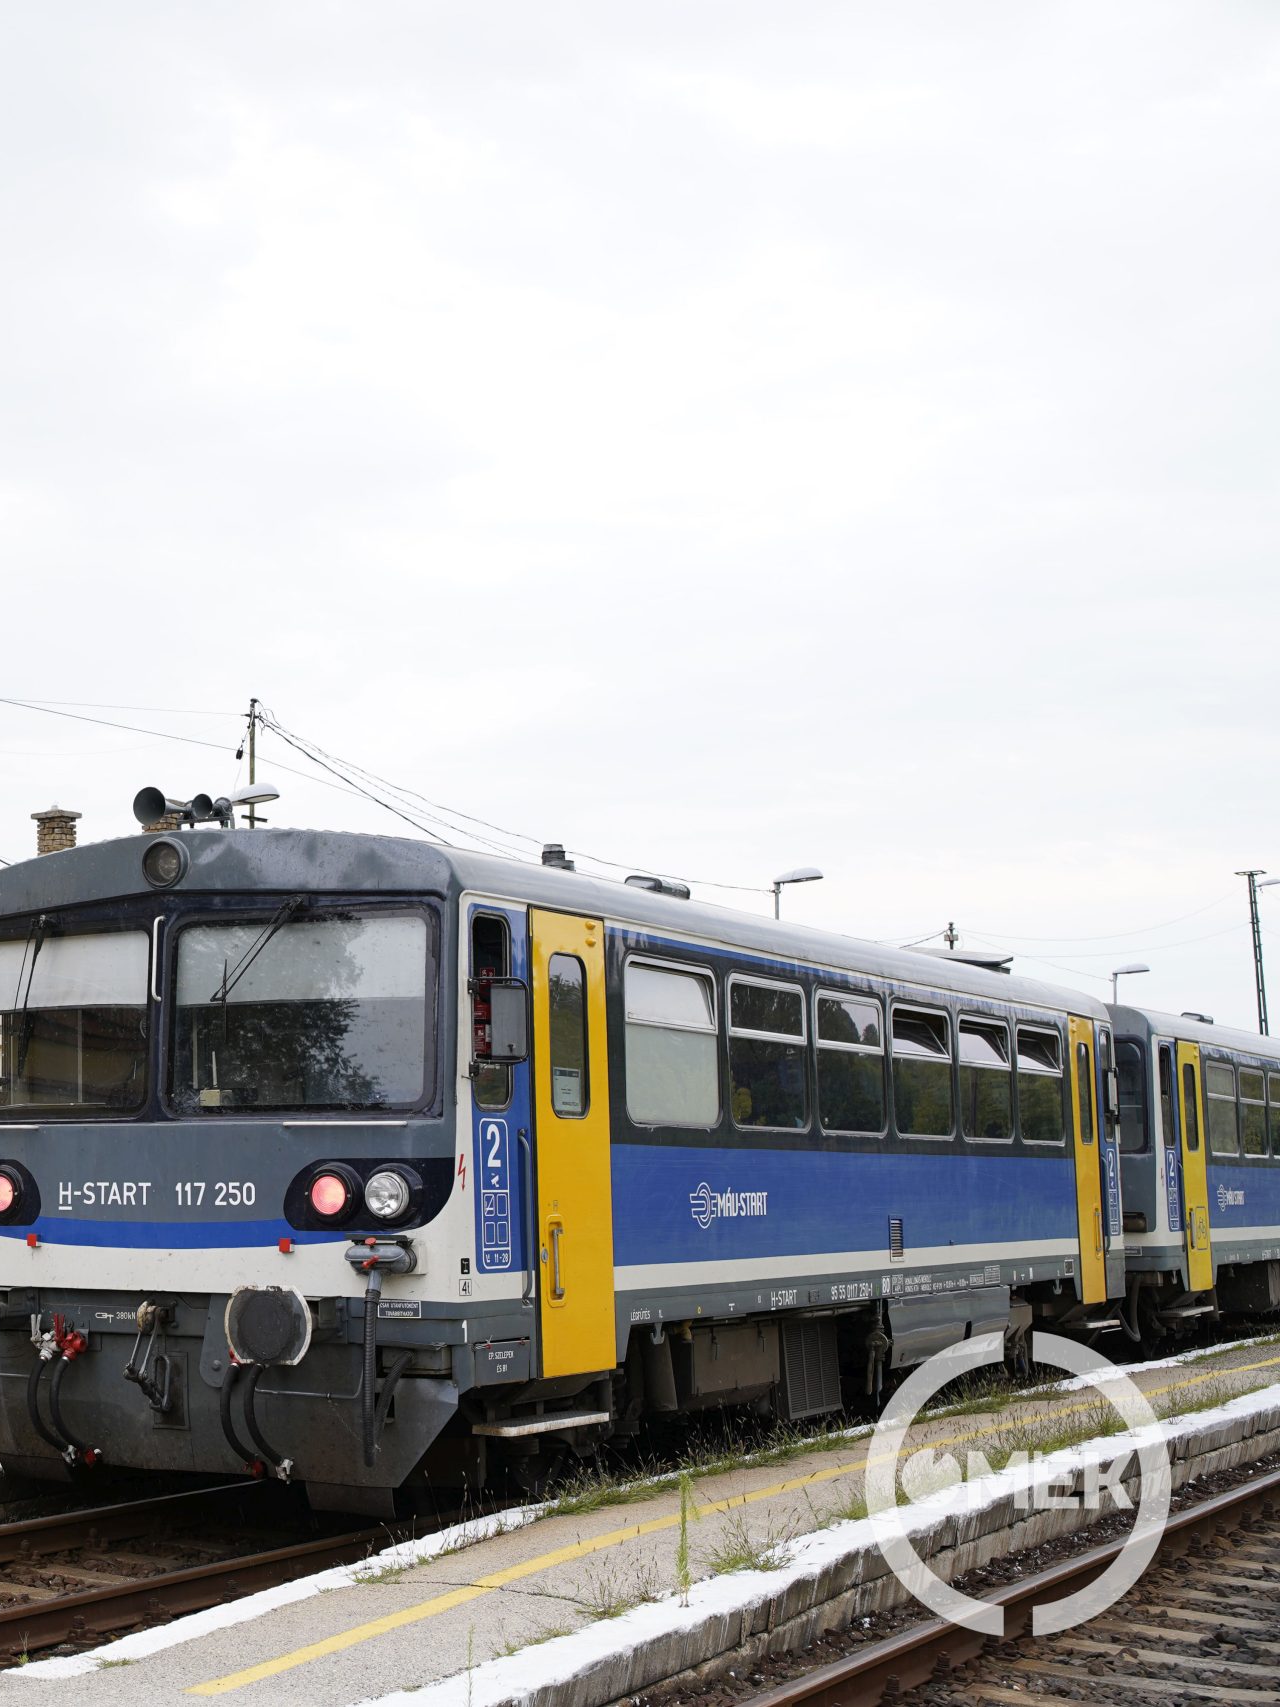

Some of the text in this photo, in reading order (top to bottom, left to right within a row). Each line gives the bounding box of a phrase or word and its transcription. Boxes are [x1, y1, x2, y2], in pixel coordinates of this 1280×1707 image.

[486, 1123, 502, 1168] 2
[1108, 1151, 1115, 1177] 2
[1168, 1153, 1175, 1177] 2
[58, 1181, 256, 1210] H-START 117 250
[461, 1319, 468, 1344] 1
